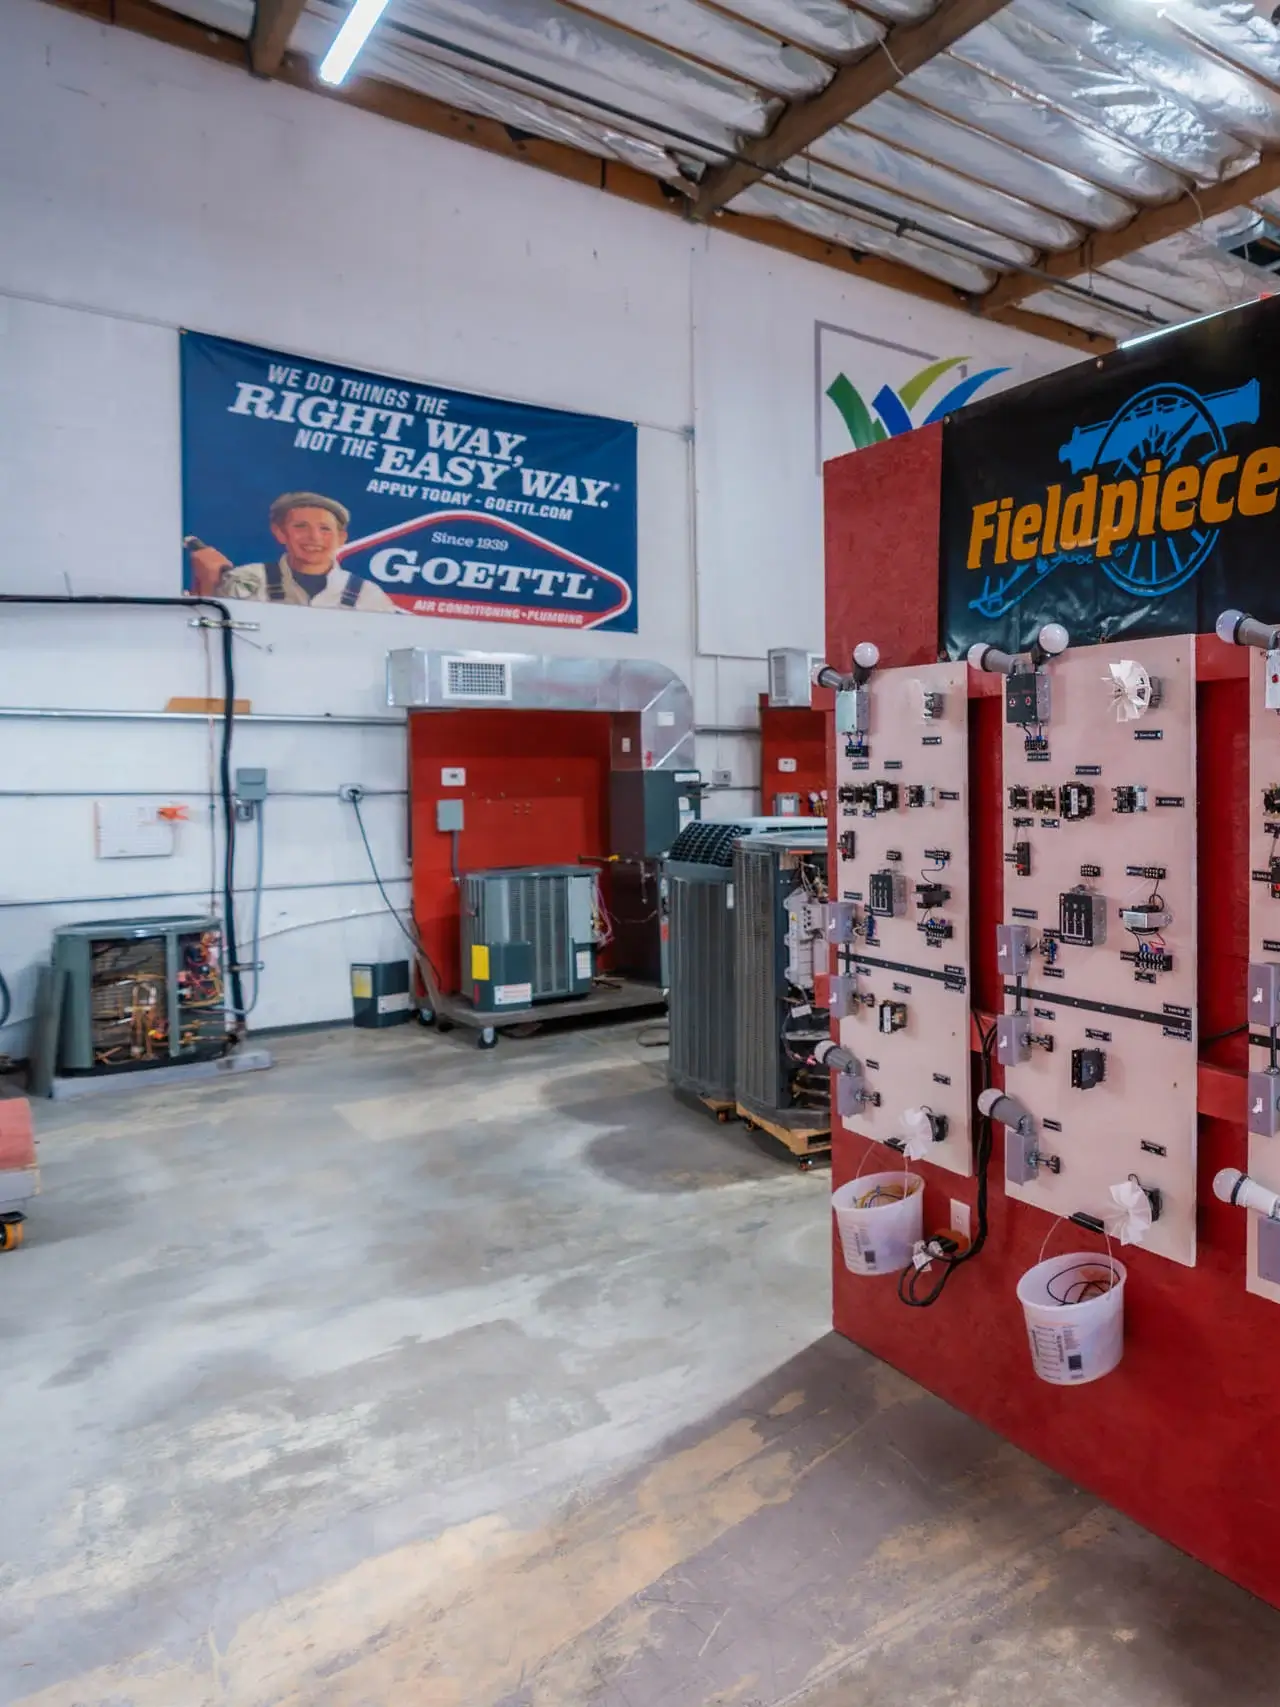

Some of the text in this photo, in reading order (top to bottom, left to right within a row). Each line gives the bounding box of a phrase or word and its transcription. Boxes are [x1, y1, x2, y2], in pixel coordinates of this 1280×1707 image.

[267, 363, 449, 417] WE DO THINGS THE
[227, 381, 527, 468] RIGHT WAY,
[293, 428, 379, 460] NOT THE
[374, 443, 511, 492] EASY
[366, 478, 418, 498] APPLY
[421, 486, 472, 506] TODAY
[484, 496, 573, 521] GOETTL.COM
[431, 531, 509, 551] Since 1939
[369, 547, 594, 600] GOETTL
[413, 599, 584, 625] AIR CONDITIONING PLUMBING
